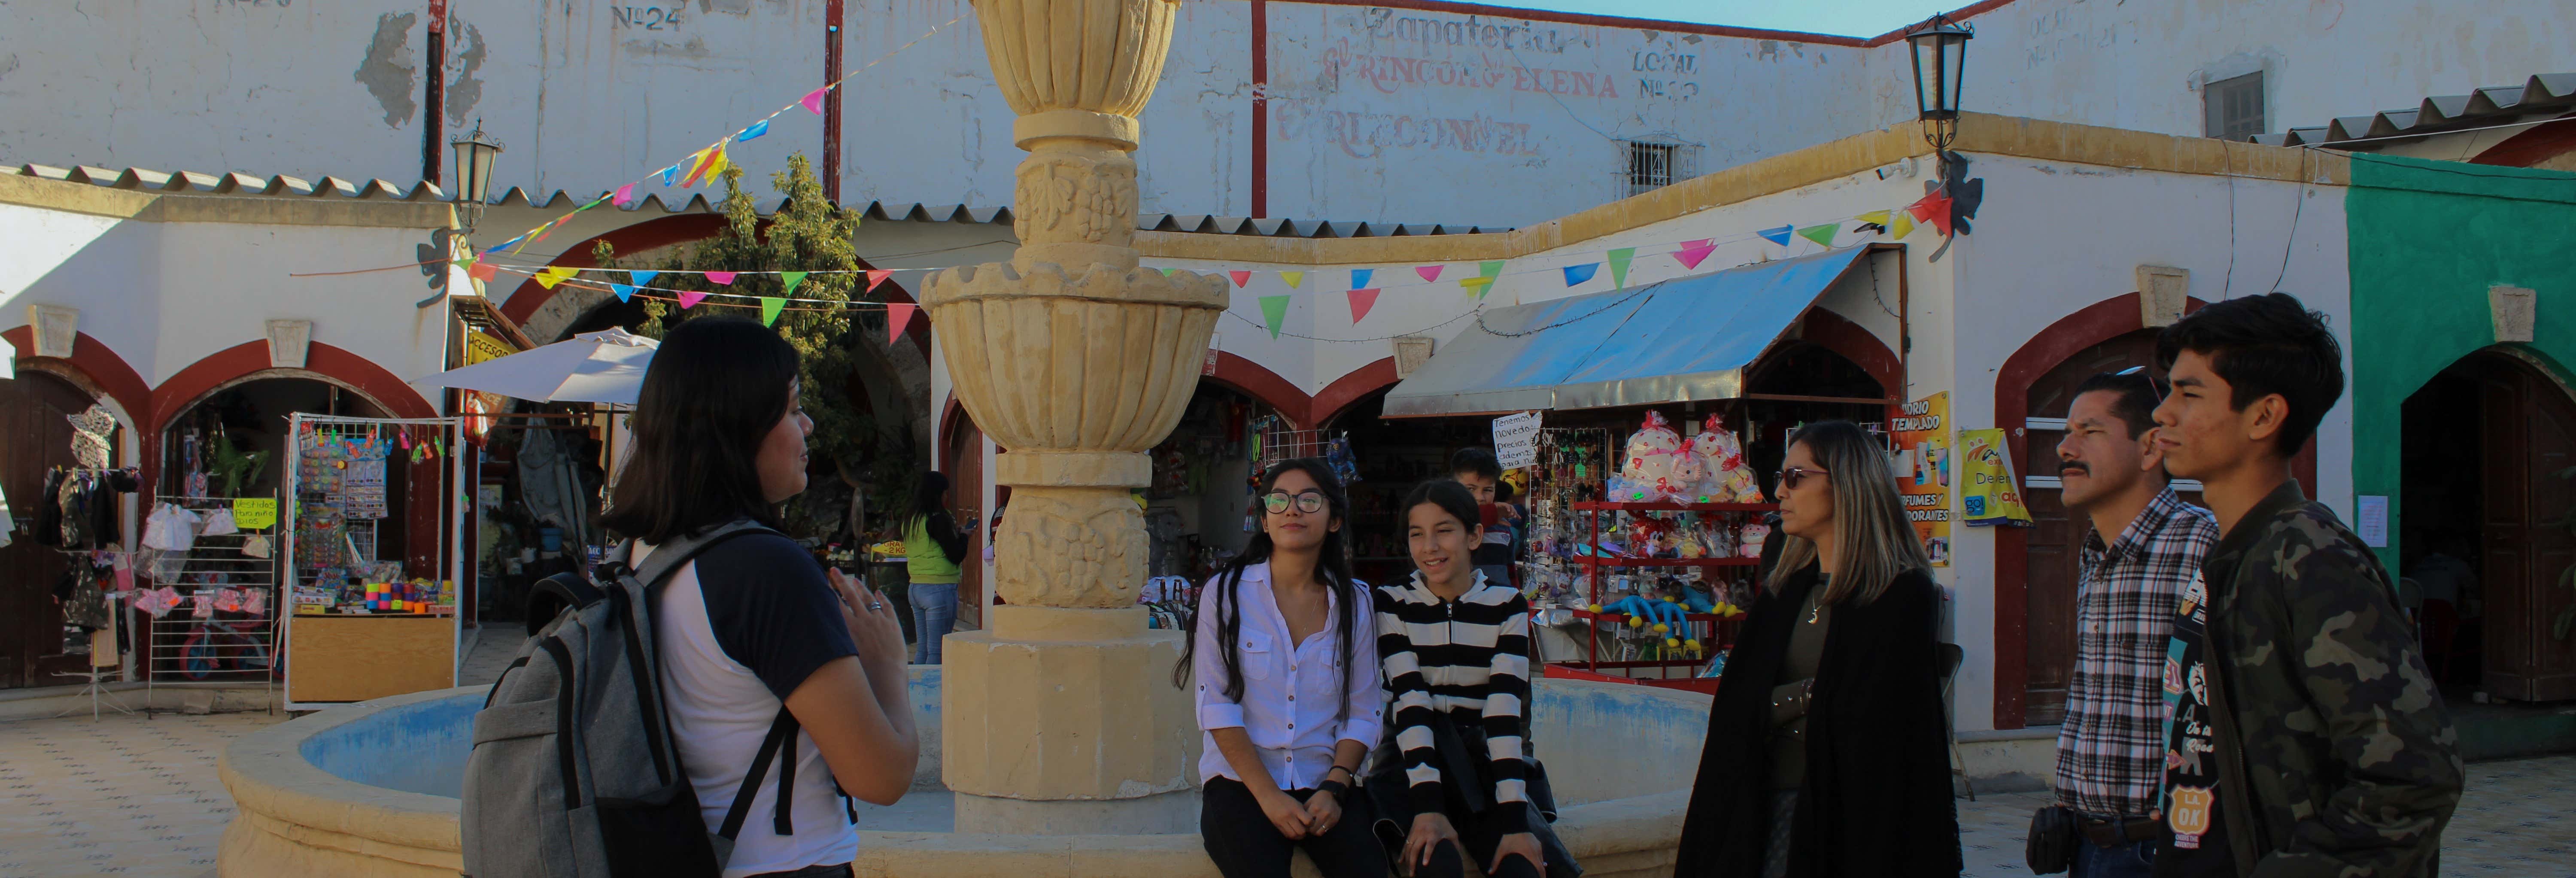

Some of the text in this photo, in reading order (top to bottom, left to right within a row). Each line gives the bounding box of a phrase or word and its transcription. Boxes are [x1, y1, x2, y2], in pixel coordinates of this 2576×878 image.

[1512, 66, 1619, 99] ELENA
[1494, 415, 1530, 428] Tenemos
[1892, 415, 1940, 431] TEMPLADO
[1497, 440, 1527, 453] precios
[235, 500, 276, 509] Vestidos
[1938, 494, 1944, 506] Y
[1965, 497, 1984, 513] go!
[2178, 808, 2199, 826] OK
